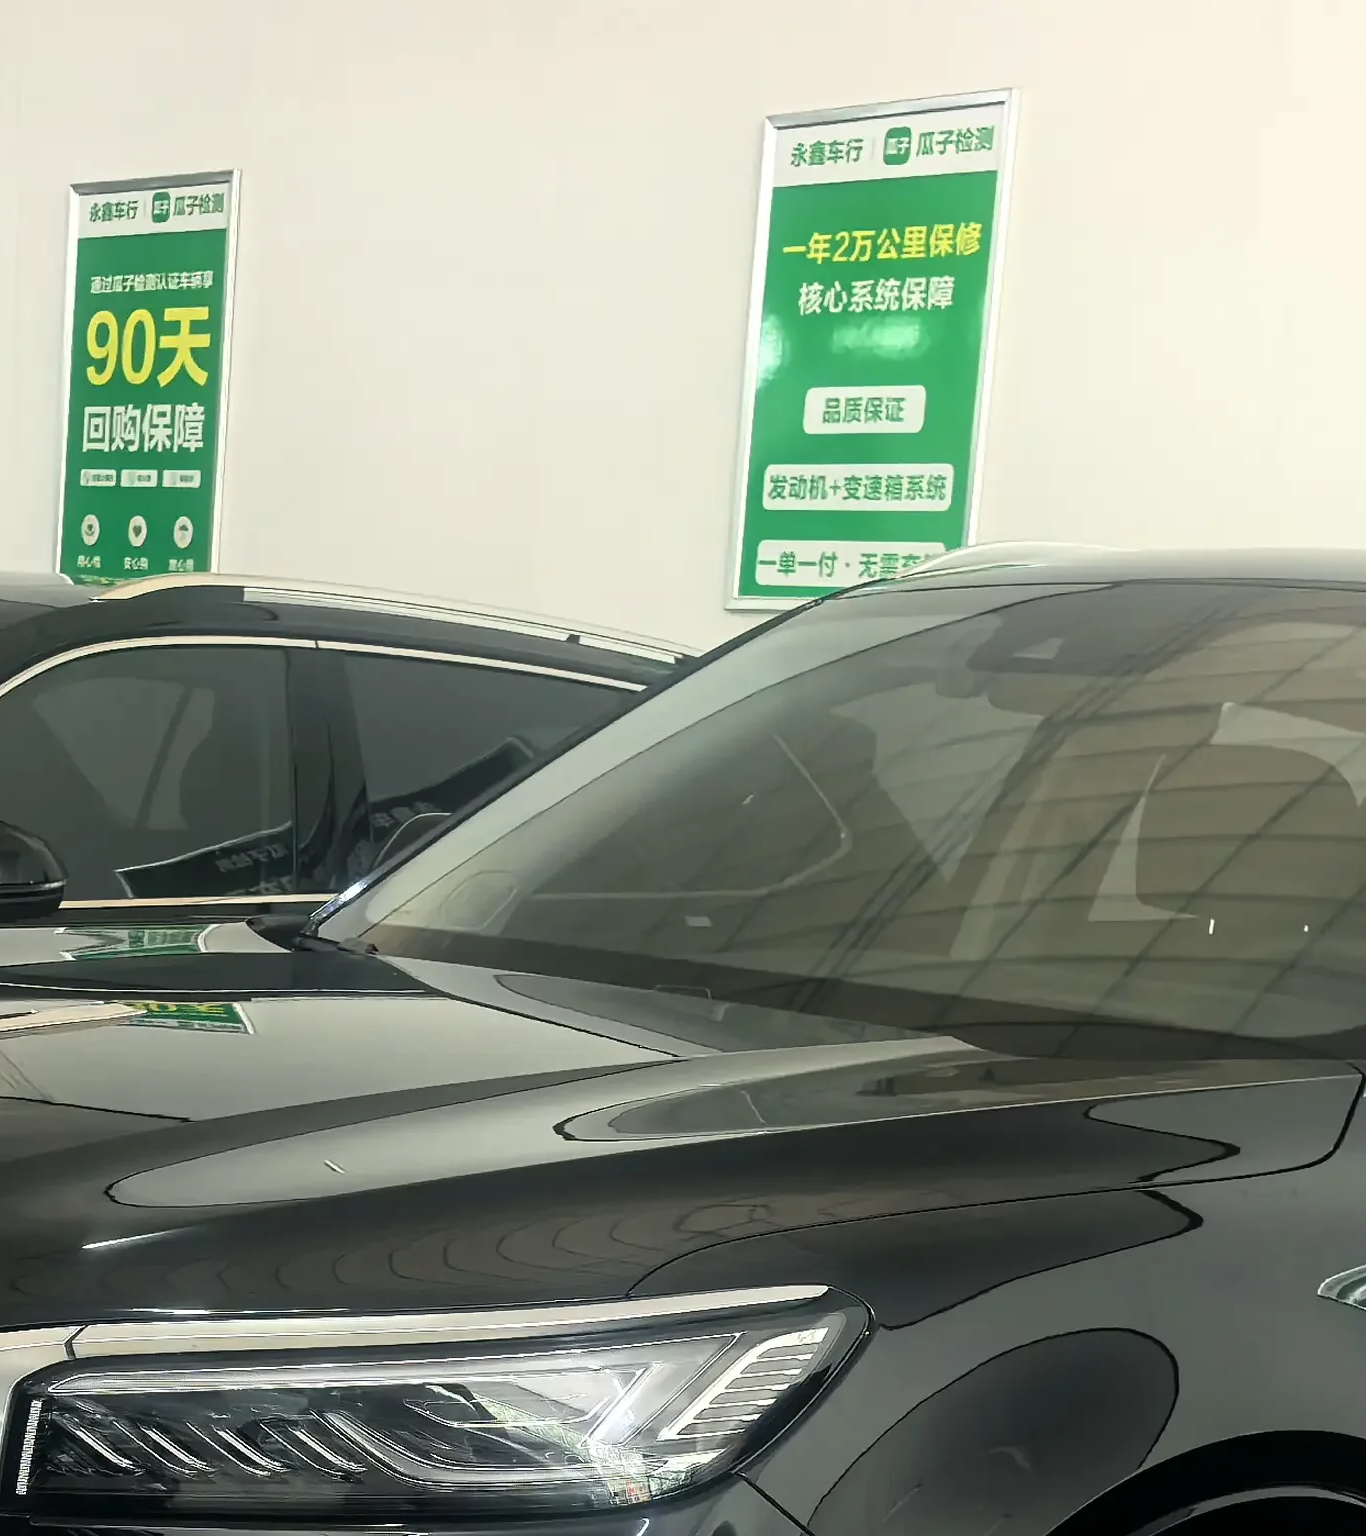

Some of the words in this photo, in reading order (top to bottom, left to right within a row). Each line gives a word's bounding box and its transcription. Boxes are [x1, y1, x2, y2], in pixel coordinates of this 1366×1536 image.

[790, 137, 864, 167] 永鑫车行
[916, 126, 995, 157] 瓜子检测
[782, 221, 983, 265] 一年2万公里保修
[797, 275, 955, 316] 核心系统保障
[86, 306, 212, 388] 90天
[82, 402, 205, 453] 回购保障
[822, 397, 906, 424] 品质保证
[767, 474, 948, 501] 发动机+变速箱系统
